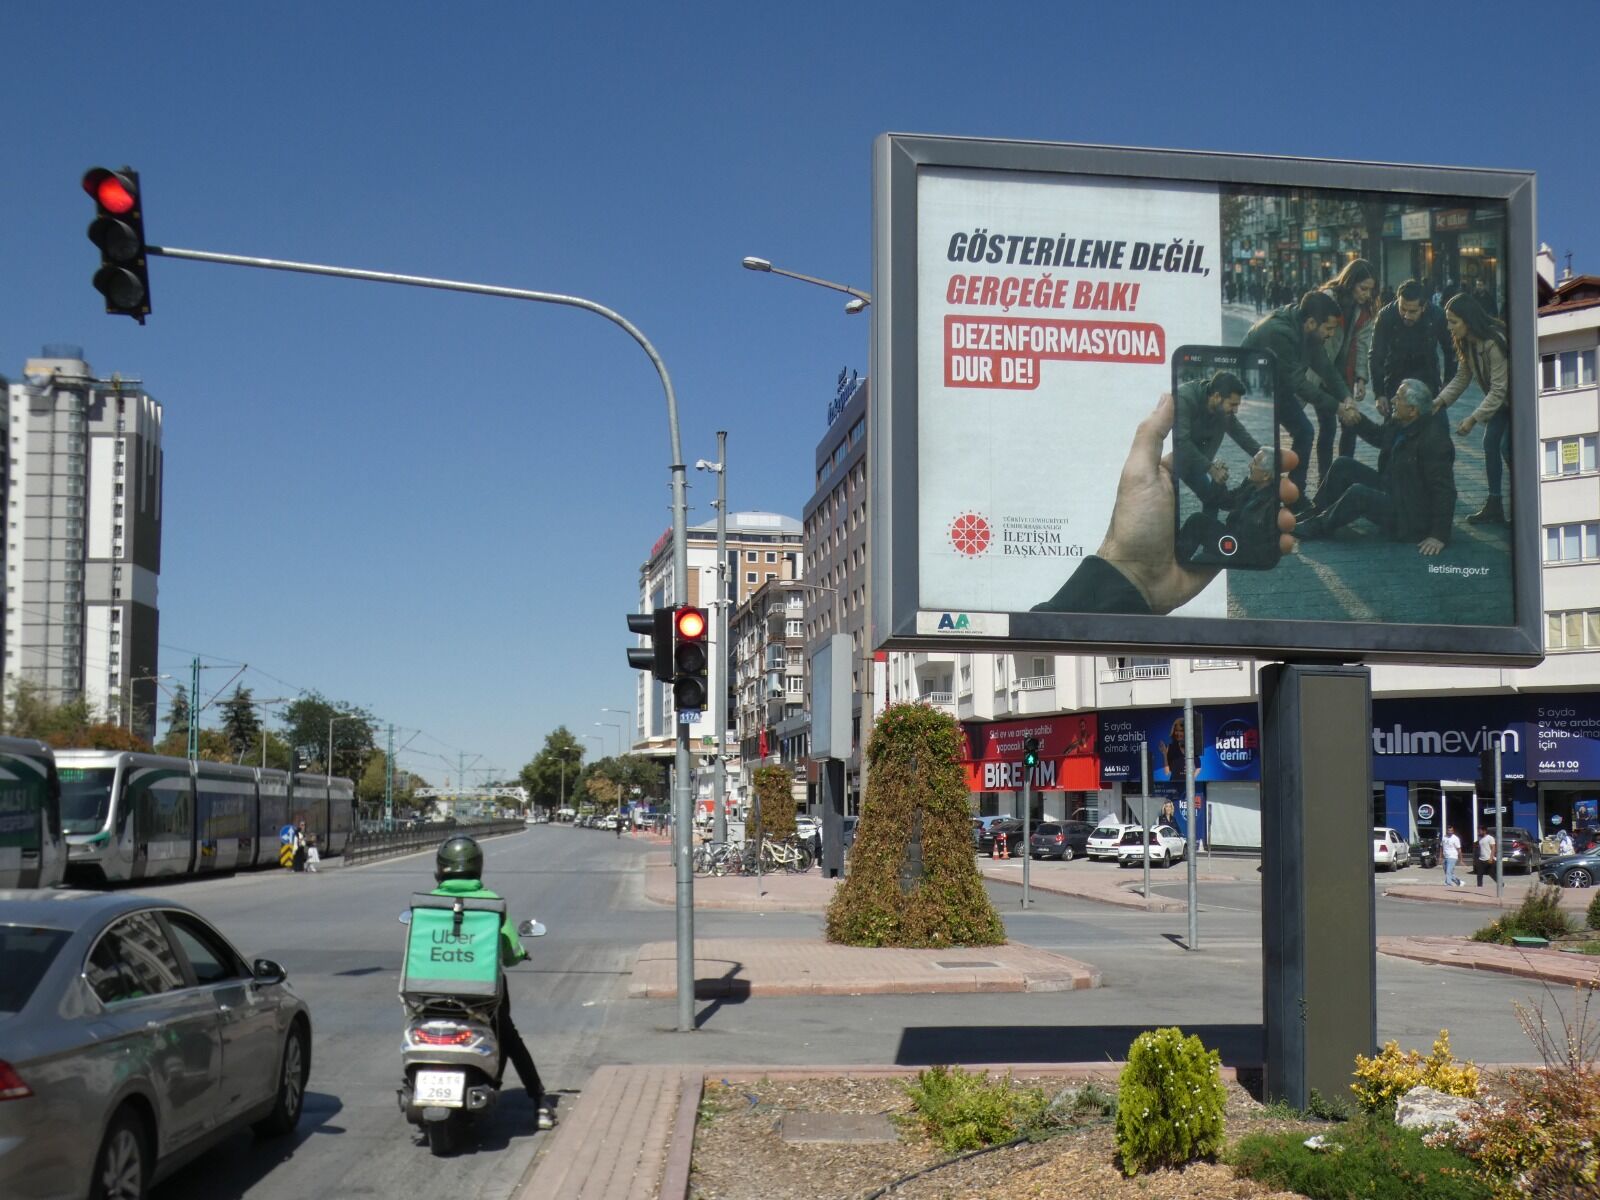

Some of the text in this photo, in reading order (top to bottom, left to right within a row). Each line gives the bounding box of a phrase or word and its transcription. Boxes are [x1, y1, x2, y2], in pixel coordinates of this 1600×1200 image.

[946, 229, 1210, 277] GÖSTERİLENE DEĞİL,
[946, 273, 1140, 312] GERÇEĞE BAK!
[951, 323, 1160, 357] DEZENFORMASYONA
[951, 356, 1033, 384] DUR DE!
[1004, 529, 1061, 545] İLETİŞİM
[1004, 544, 1084, 558] BAŞKANLIĞI
[1428, 564, 1490, 577] iletisim.gov.tr
[938, 614, 970, 629] AA
[680, 712, 700, 720] 117A
[1538, 708, 1576, 718] 5 ayda
[1034, 725, 1052, 735] sahibi
[1104, 722, 1132, 732] 5 ayda
[1104, 731, 1146, 742] ev sahibi
[1538, 730, 1570, 738] sahibi
[1216, 736, 1244, 750] katıl
[1538, 740, 1556, 750] için
[1220, 749, 1252, 760] derim!
[432, 929, 476, 944] Uber
[431, 946, 474, 962] Eats
[427, 1088, 452, 1098] 269
